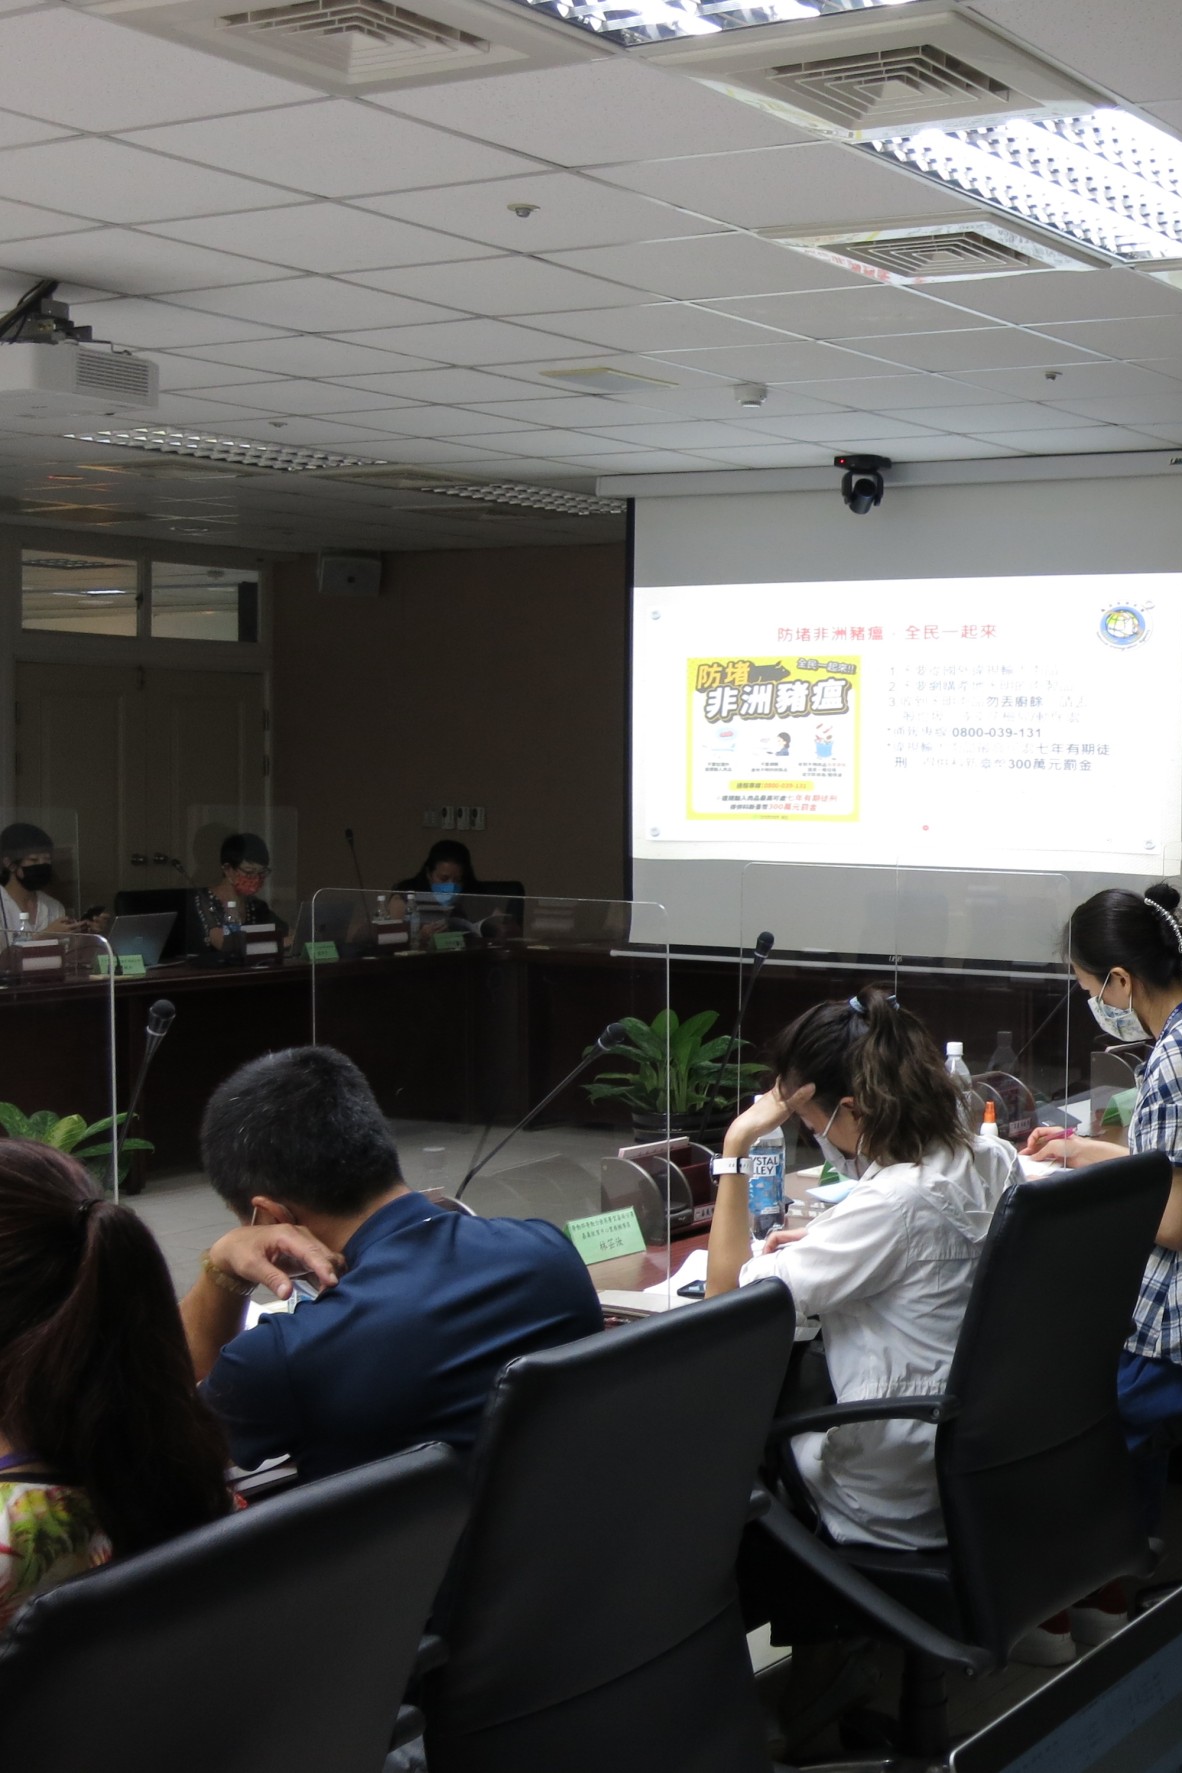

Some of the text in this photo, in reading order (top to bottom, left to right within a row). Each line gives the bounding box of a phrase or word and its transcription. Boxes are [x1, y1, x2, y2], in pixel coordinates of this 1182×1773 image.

[696, 660, 752, 690] 防堵
[704, 678, 849, 720] 非洲豬瘟
[952, 727, 1042, 738] 0800-039-131
